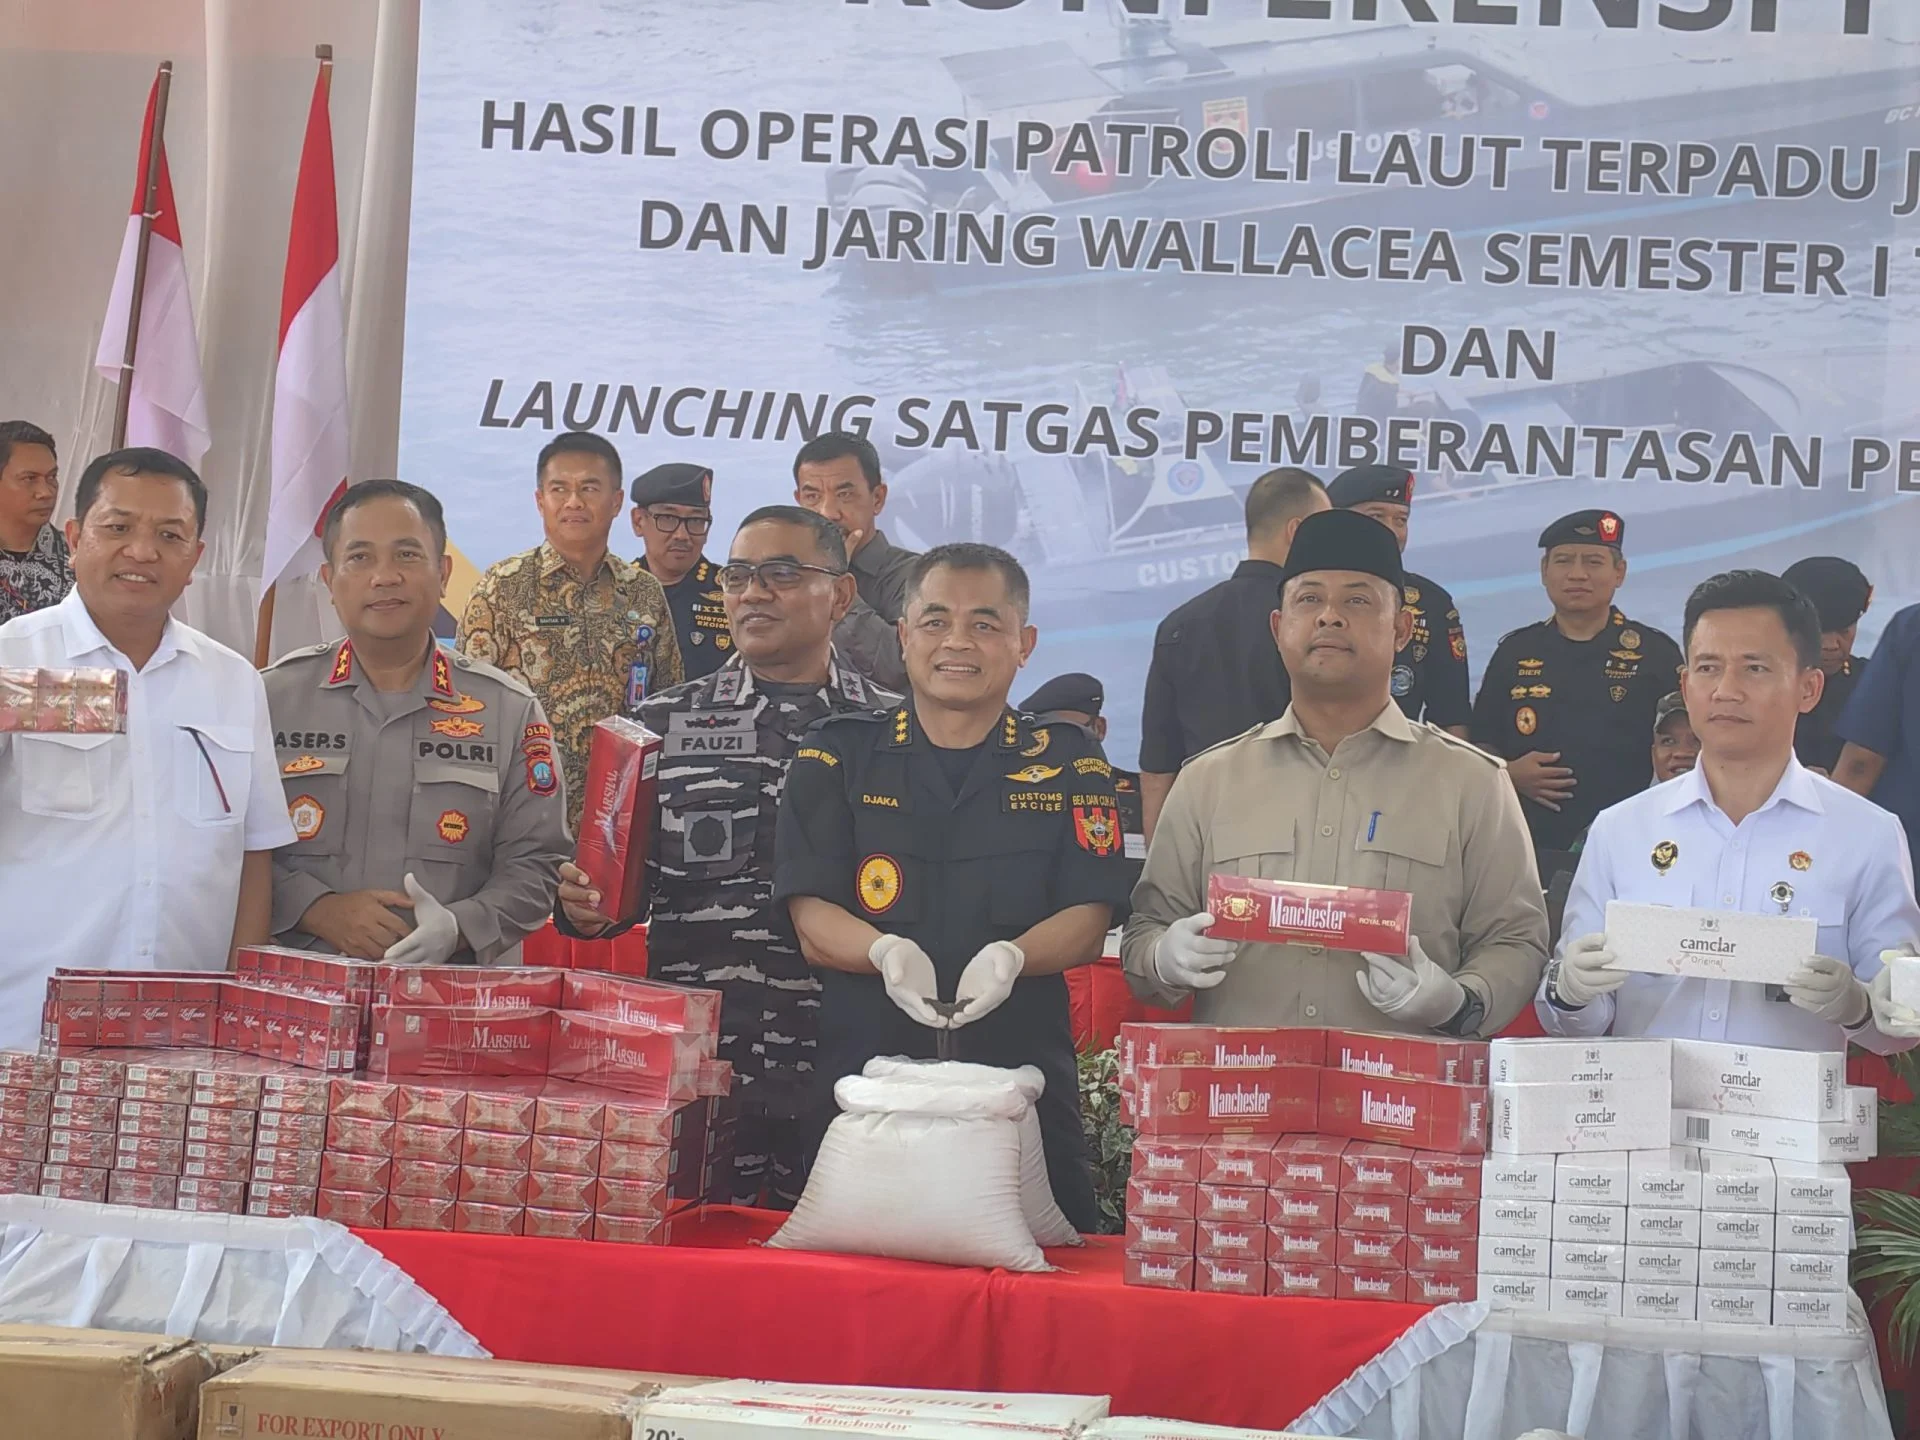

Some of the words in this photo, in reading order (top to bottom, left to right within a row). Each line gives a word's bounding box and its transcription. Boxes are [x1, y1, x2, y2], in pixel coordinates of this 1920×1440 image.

[480, 100, 676, 157] HASIL
[700, 108, 989, 170] OPERASI
[1015, 120, 1310, 181] PATROLI
[1338, 132, 1522, 190] LAUT
[1542, 139, 1878, 199] TERPADU
[639, 199, 788, 255] DAN
[803, 207, 1057, 269] JARING
[1079, 217, 1463, 282] WALLACEA
[1483, 233, 1848, 297] SEMESTER
[1872, 246, 1889, 297] I
[1401, 325, 1556, 382] DAN
[479, 379, 877, 443] LAUNCHING
[894, 398, 1159, 459] SATGAS
[1184, 410, 1822, 489] PEMBERANTASAN
[680, 736, 743, 751] FAUZI
[418, 741, 494, 763] POLRI
[594, 769, 619, 830] MARSHAL
[862, 794, 899, 808] DJAKA
[1009, 792, 1064, 802] CUSTOMS
[1010, 801, 1063, 812] EXCISE
[1268, 895, 1347, 931] Manchester
[1358, 917, 1381, 926] ROYAL
[1381, 919, 1396, 927] RED
[1680, 936, 1737, 953] camclar
[475, 988, 533, 1010] MARSHAL
[471, 1026, 531, 1049] MARSHAL
[603, 1038, 648, 1068] MARSHAL
[1721, 1071, 1761, 1087] camclar
[1208, 1083, 1271, 1117] Manchester
[1361, 1090, 1416, 1127] Manchester
[1575, 1107, 1616, 1124] camclar
[1731, 1128, 1760, 1141] camclar
[1829, 1132, 1860, 1146] camclar
[1357, 1166, 1393, 1182] Manchester
[1495, 1170, 1538, 1183] camclar
[1568, 1175, 1611, 1188] camclar
[1641, 1179, 1685, 1192] camclar
[1716, 1182, 1759, 1195] camclar
[1790, 1184, 1833, 1198] camclar
[1425, 1208, 1462, 1224] Manchester
[1495, 1207, 1538, 1219] camclar
[1568, 1213, 1611, 1225] camclar
[1640, 1216, 1683, 1229] camclar
[1716, 1220, 1760, 1233] camclar
[1792, 1223, 1835, 1236] camclar
[1493, 1244, 1536, 1257] camclar
[1565, 1250, 1608, 1263] camclar
[1638, 1254, 1682, 1267] camclar
[1713, 1258, 1757, 1271] camclar
[1790, 1261, 1833, 1274] camclar
[1492, 1282, 1535, 1295] camclar
[1565, 1287, 1608, 1300] camclar
[1636, 1292, 1679, 1305] camclar
[1711, 1296, 1755, 1309] camclar
[1787, 1299, 1831, 1313] camclar
[257, 1413, 299, 1436] FOR
[303, 1416, 385, 1440] EXPORT
